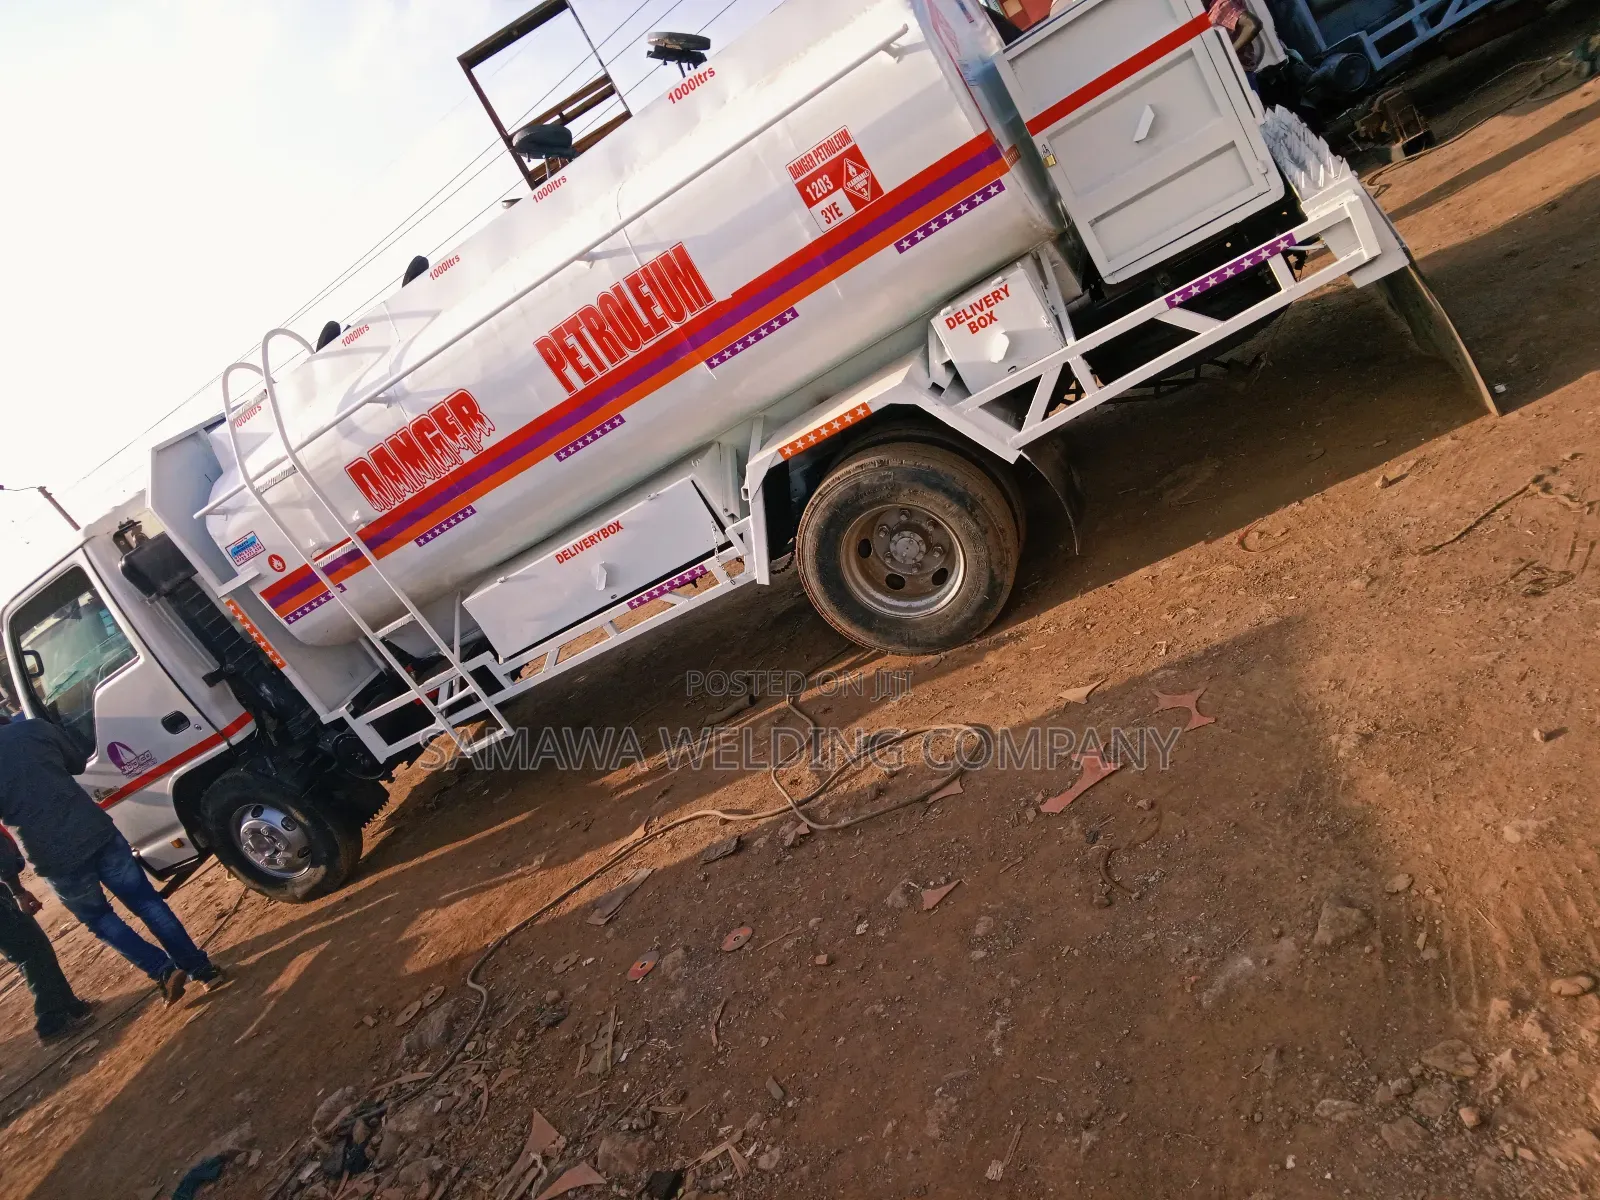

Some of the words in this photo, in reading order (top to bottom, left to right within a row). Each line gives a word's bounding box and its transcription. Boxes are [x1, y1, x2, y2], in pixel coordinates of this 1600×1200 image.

[667, 66, 716, 105] 1000ltrs
[787, 154, 818, 180] DANGER
[812, 128, 853, 164] PETROLEUM
[532, 175, 567, 203] 1000ltrs
[805, 174, 834, 201] 1203
[860, 187, 868, 196] 3
[820, 201, 843, 225] 3YE
[429, 254, 460, 281] 1000ltrs
[533, 241, 717, 396] PETROLEUM
[944, 283, 1010, 330] DELIVERY
[341, 323, 370, 347] 1000ltrs
[966, 310, 998, 335] BOX
[344, 388, 495, 512] DANGER
[554, 520, 624, 565] DELIVERYBOX
